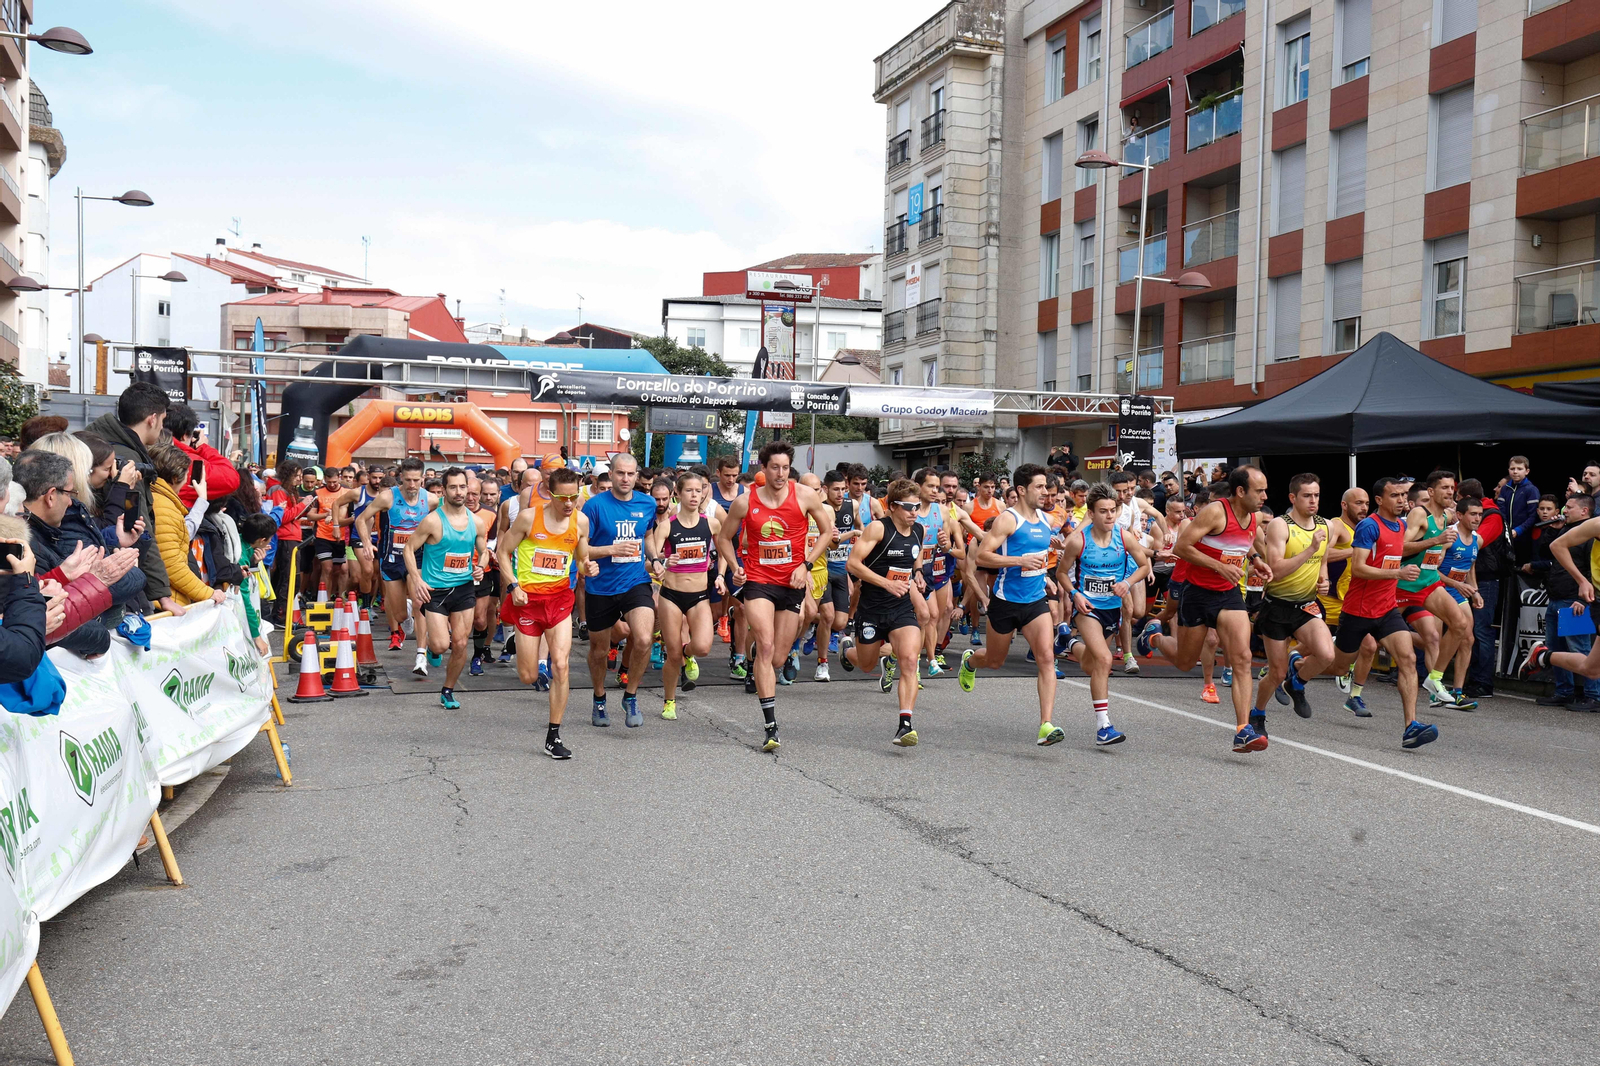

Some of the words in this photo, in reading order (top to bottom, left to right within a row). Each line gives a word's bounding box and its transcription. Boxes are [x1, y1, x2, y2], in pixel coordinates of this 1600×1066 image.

[910, 192, 920, 216] 19
[749, 272, 796, 280] RESTAURANTE
[153, 365, 184, 373] Porriño
[616, 377, 680, 392] Concello
[684, 380, 703, 393] do
[708, 381, 767, 396] Porriño
[640, 393, 648, 402] O
[651, 394, 687, 404] Concello
[689, 395, 701, 404] do
[703, 396, 737, 406] Deporte
[807, 401, 839, 410] Porriño
[396, 407, 452, 421] GADIS
[882, 404, 913, 415] Grupo
[915, 406, 948, 416] Godoy
[950, 406, 987, 416] Maceira
[1087, 460, 1105, 469] Carril
[1106, 460, 1111, 468] 3
[616, 522, 636, 537] 10K
[682, 549, 698, 559] 387
[764, 548, 784, 559] 1075
[450, 558, 465, 568] 678
[542, 557, 557, 569] 123
[1089, 582, 1109, 592] 1596
[184, 672, 215, 706] RAMA
[83, 727, 122, 776] RAMA
